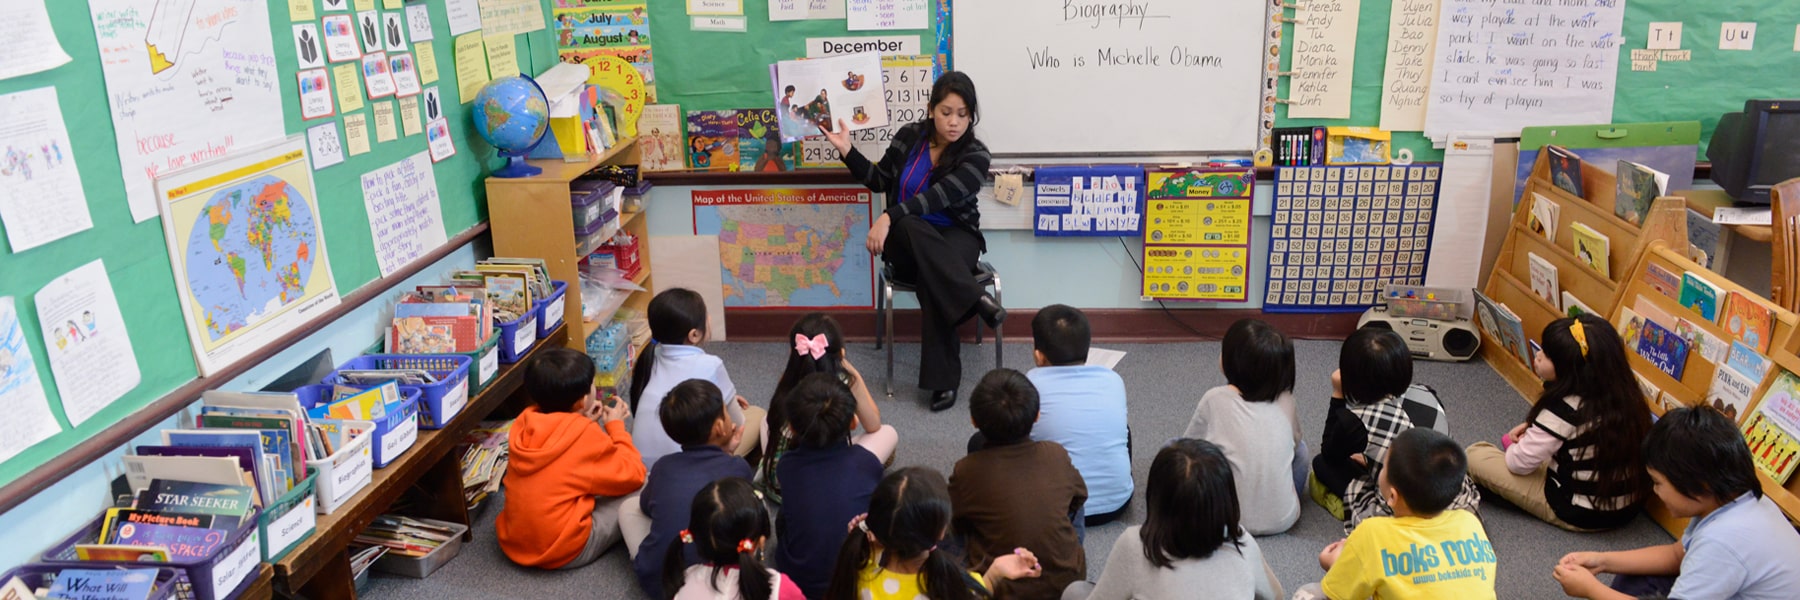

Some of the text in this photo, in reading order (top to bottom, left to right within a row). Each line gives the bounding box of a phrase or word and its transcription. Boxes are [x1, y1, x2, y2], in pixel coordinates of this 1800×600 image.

[1299, 1, 1342, 12] Theresa
[1403, 1, 1433, 16] Uyen
[589, 13, 612, 25] July
[1063, 0, 1148, 30] Biography
[1307, 13, 1333, 28] Andy
[1399, 14, 1433, 27] Julia
[1524, 14, 1539, 26] at
[1550, 14, 1565, 27] the
[583, 33, 623, 46] August
[1307, 27, 1324, 39] Tu
[1400, 28, 1424, 39] Bao
[1655, 29, 1662, 41] T
[1725, 29, 1749, 42] U u
[822, 39, 904, 54] December
[1298, 40, 1335, 53] Diana
[1392, 40, 1428, 55] Denny
[1542, 37, 1557, 48] on
[1565, 34, 1584, 48] the
[1026, 46, 1223, 70] Who is Michelle Obama
[1300, 54, 1338, 66] Monika
[1396, 53, 1423, 67] Jake
[1486, 51, 1497, 64] he
[1505, 56, 1525, 66] was
[1532, 57, 1559, 73] going
[1566, 59, 1576, 69] so
[1582, 54, 1605, 69] fast
[598, 61, 623, 75] 12 1
[1293, 66, 1337, 80] Jennifer
[1395, 67, 1424, 83] Thuy
[625, 74, 633, 85] 2
[883, 70, 927, 83] 5 6 7
[1512, 77, 1528, 87] see
[1534, 73, 1554, 88] him
[1581, 80, 1604, 90] was
[1298, 81, 1328, 92] Katila
[1391, 82, 1428, 98] Quang
[631, 89, 639, 100] 3
[897, 89, 930, 102] 13 14
[1297, 94, 1322, 106] Linh
[1439, 91, 1543, 110] so of playin
[625, 103, 633, 114] 4
[896, 109, 913, 122] 20
[737, 110, 760, 126] Celia
[860, 128, 894, 141] 25 26
[135, 129, 177, 156] because
[805, 148, 840, 160] 29 30
[167, 154, 186, 171] love
[1427, 169, 1438, 179] 10
[1041, 185, 1066, 193] Vowels
[1281, 184, 1433, 193] 11 12 13 14 15 16 17 18 19 20
[694, 192, 857, 205] Map of the United States of America
[1649, 346, 1669, 362] The Little
[1731, 347, 1749, 364] BEAR
[1658, 360, 1675, 376] Owl
[1717, 368, 1733, 387] PINK
[1731, 379, 1740, 389] and
[1739, 384, 1751, 398] SAY
[155, 493, 239, 510] STAR SEEKER
[128, 512, 200, 526] My Picture Book
[281, 517, 303, 537] Science
[1381, 532, 1497, 577] boks rocks
[217, 567, 236, 586] Solar
[1413, 567, 1487, 585] www.bokskids.org
[67, 576, 128, 593] What Will
